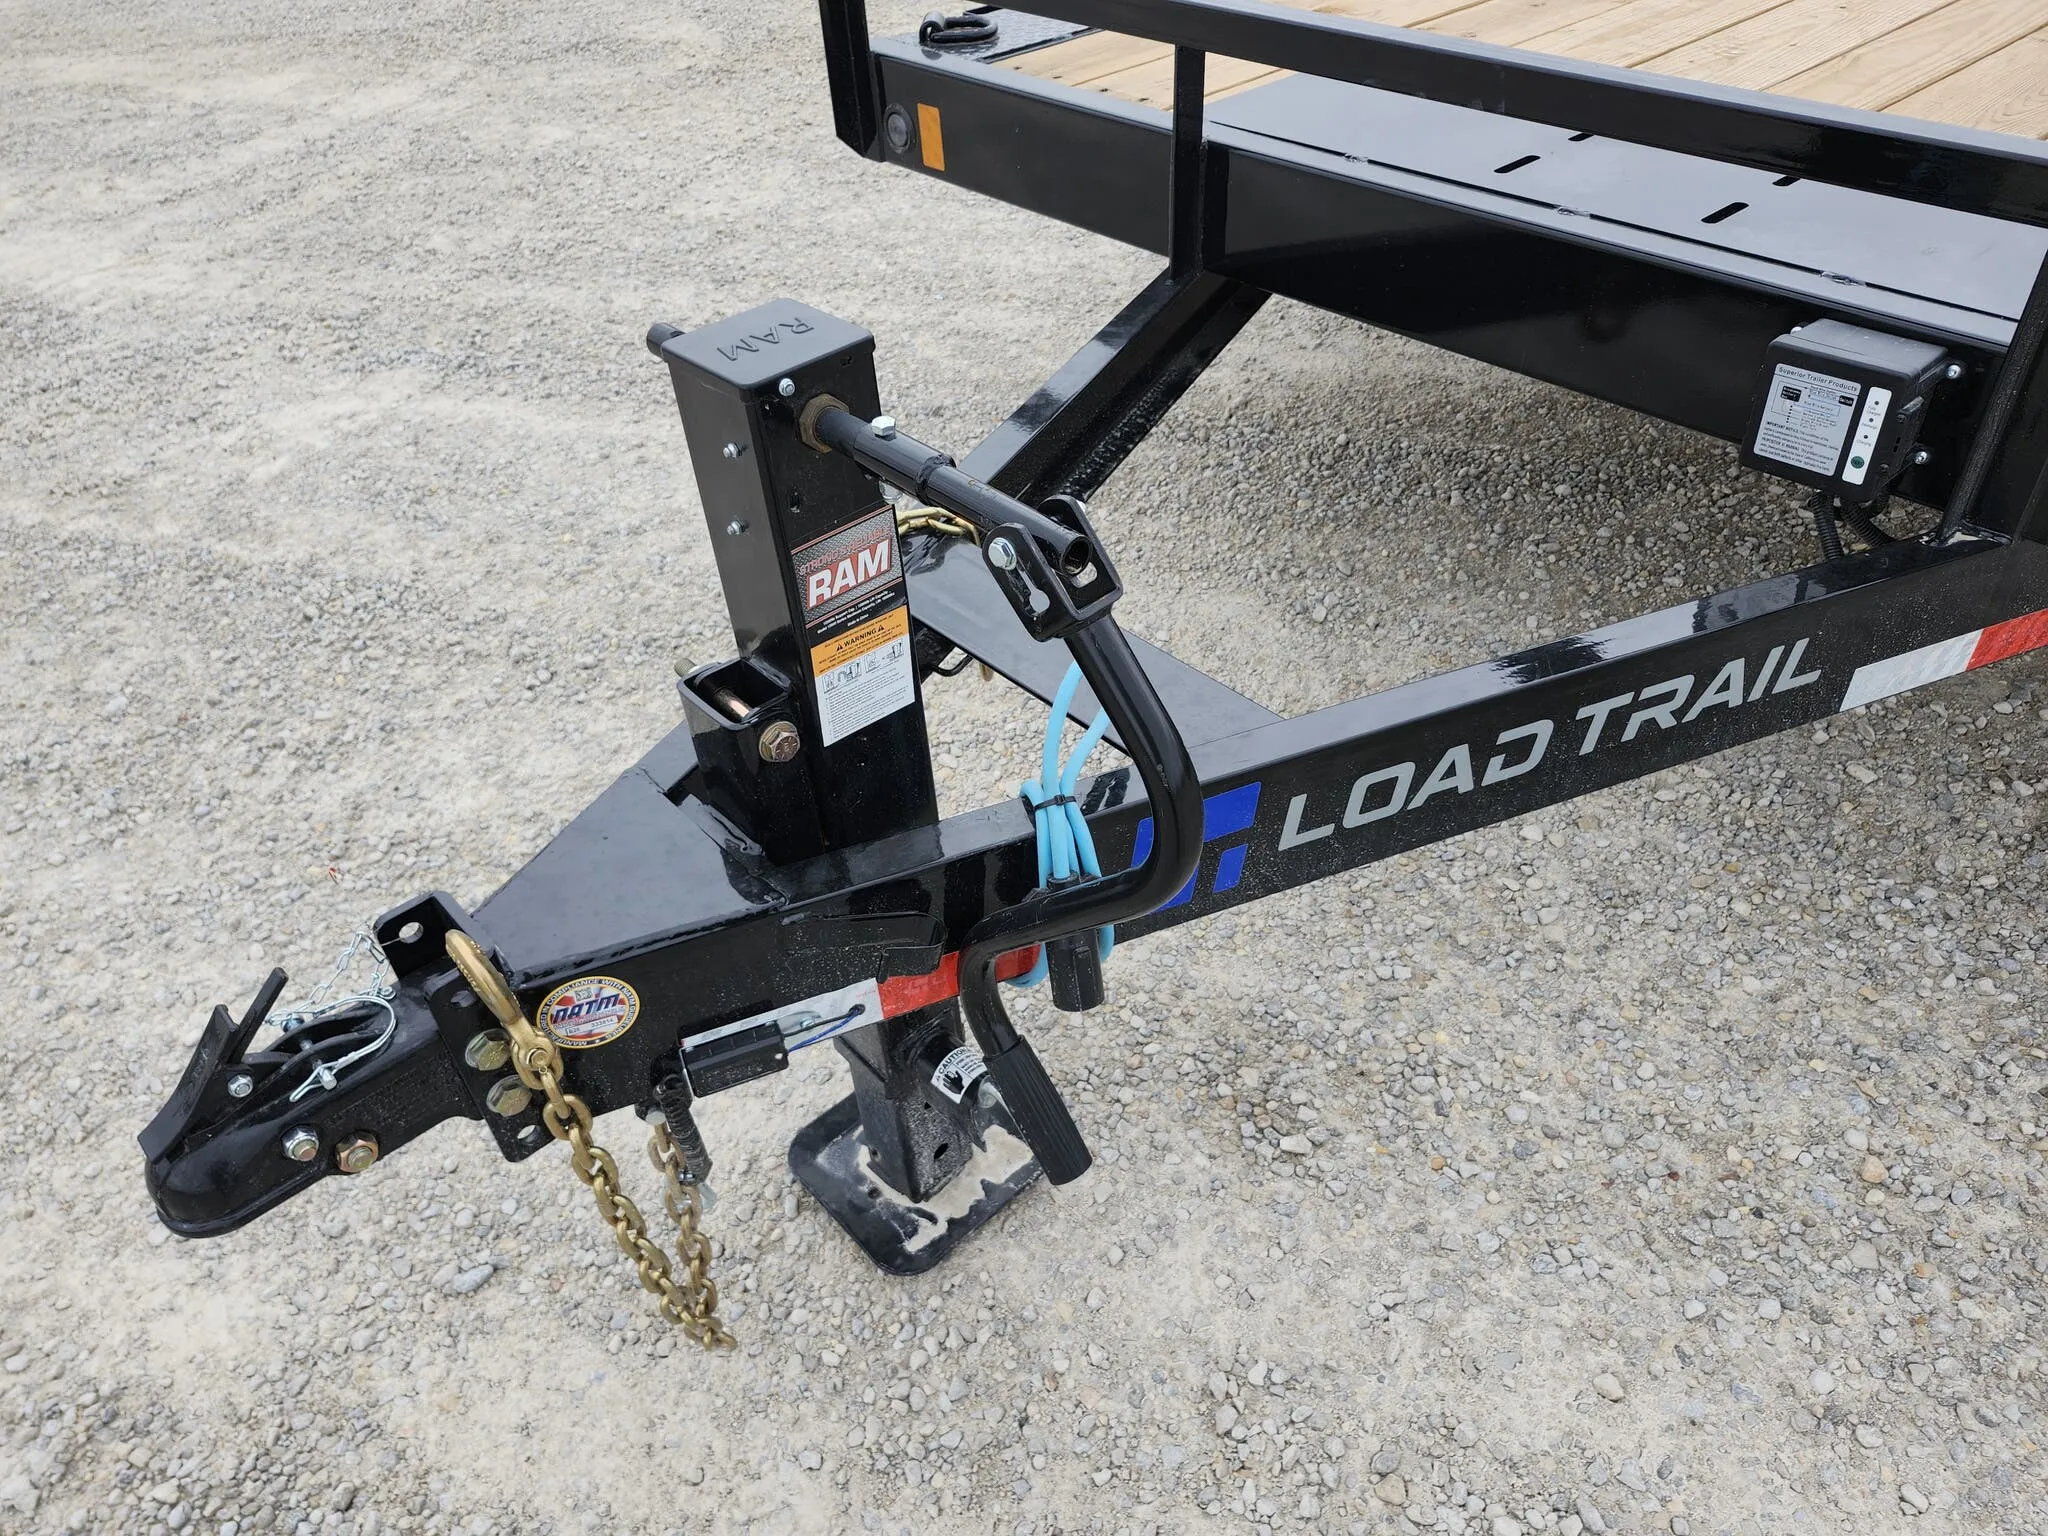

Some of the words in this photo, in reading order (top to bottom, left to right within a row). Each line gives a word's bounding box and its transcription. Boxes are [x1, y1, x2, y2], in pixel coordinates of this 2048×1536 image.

[716, 316, 814, 362] RAM
[1778, 366, 1806, 379] Superior
[1806, 373, 1829, 385] Trailer
[1828, 379, 1858, 393] Products
[808, 538, 890, 609] RAM
[844, 629, 877, 647] WARNING
[1278, 719, 1555, 852] LOAD
[1574, 636, 1823, 757] TRAIL
[547, 978, 600, 1006] COMPLIANCE
